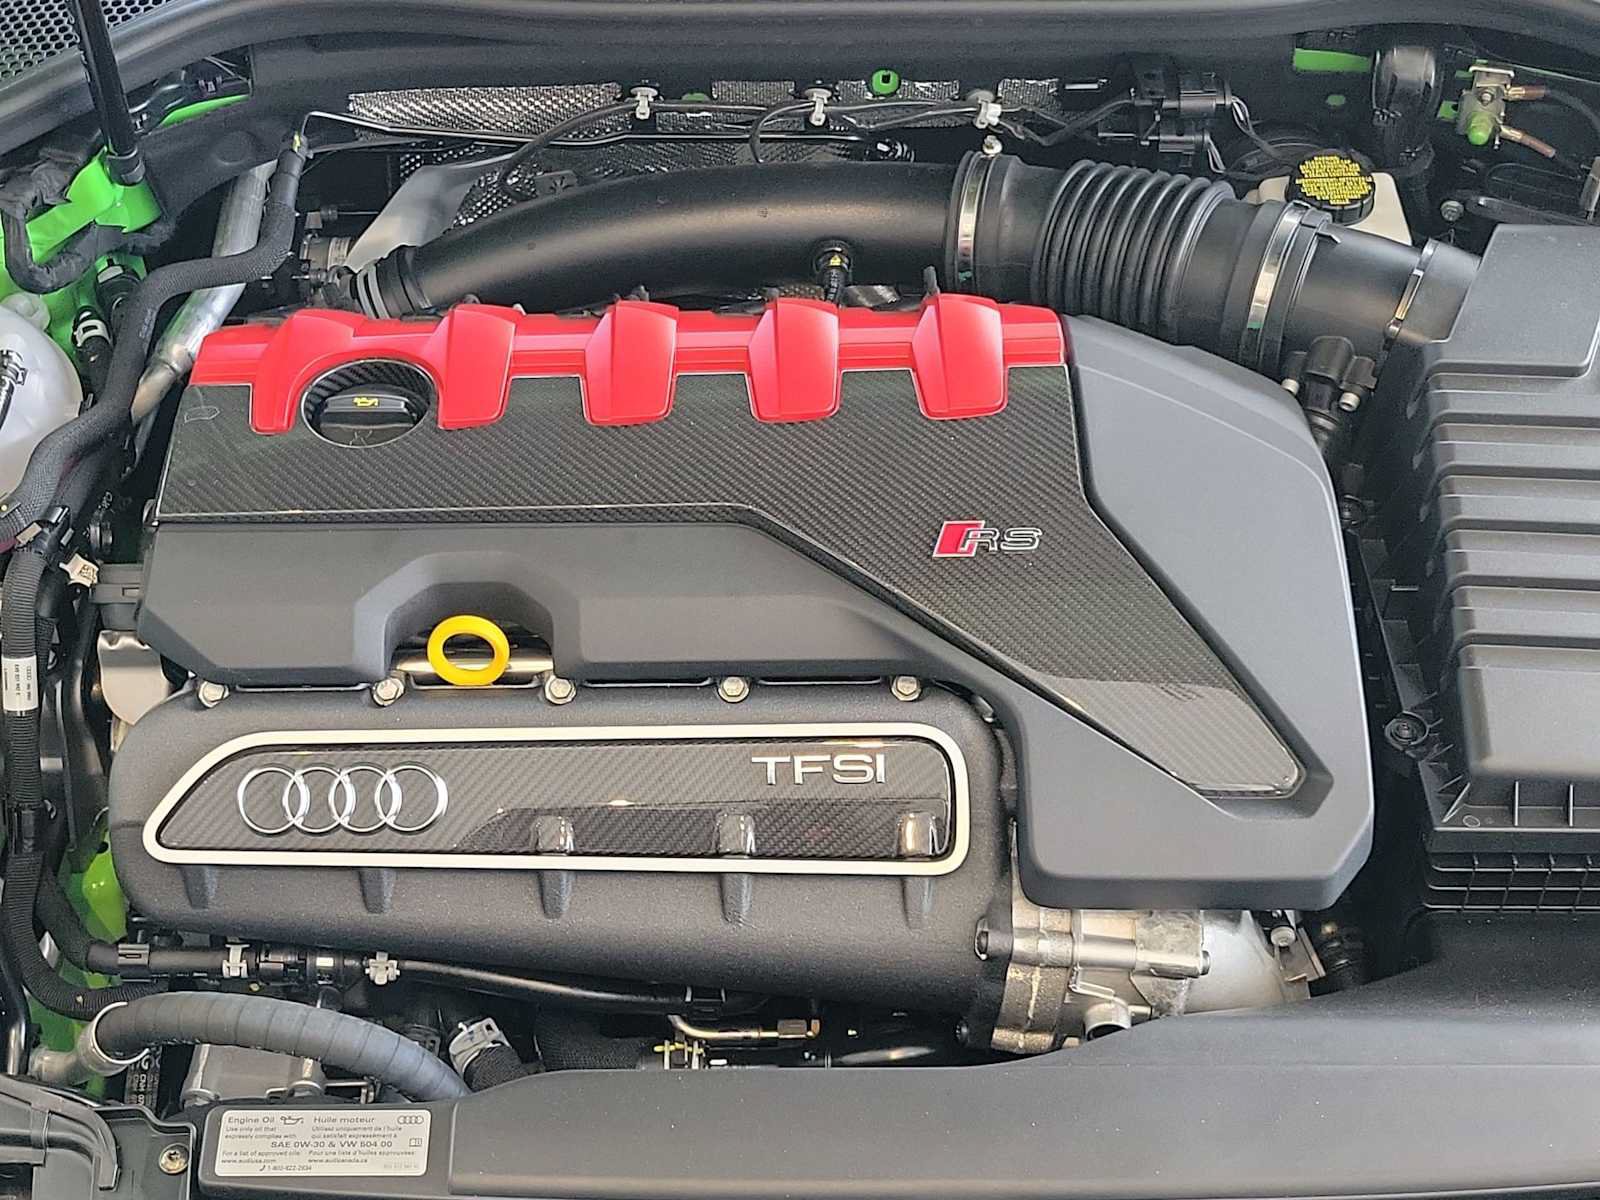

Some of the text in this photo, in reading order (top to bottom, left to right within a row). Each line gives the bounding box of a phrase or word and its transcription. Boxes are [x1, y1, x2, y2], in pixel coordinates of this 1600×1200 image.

[959, 527, 1042, 552] RS
[751, 753, 886, 785] TFSI
[228, 1115, 275, 1124] Engine Oil
